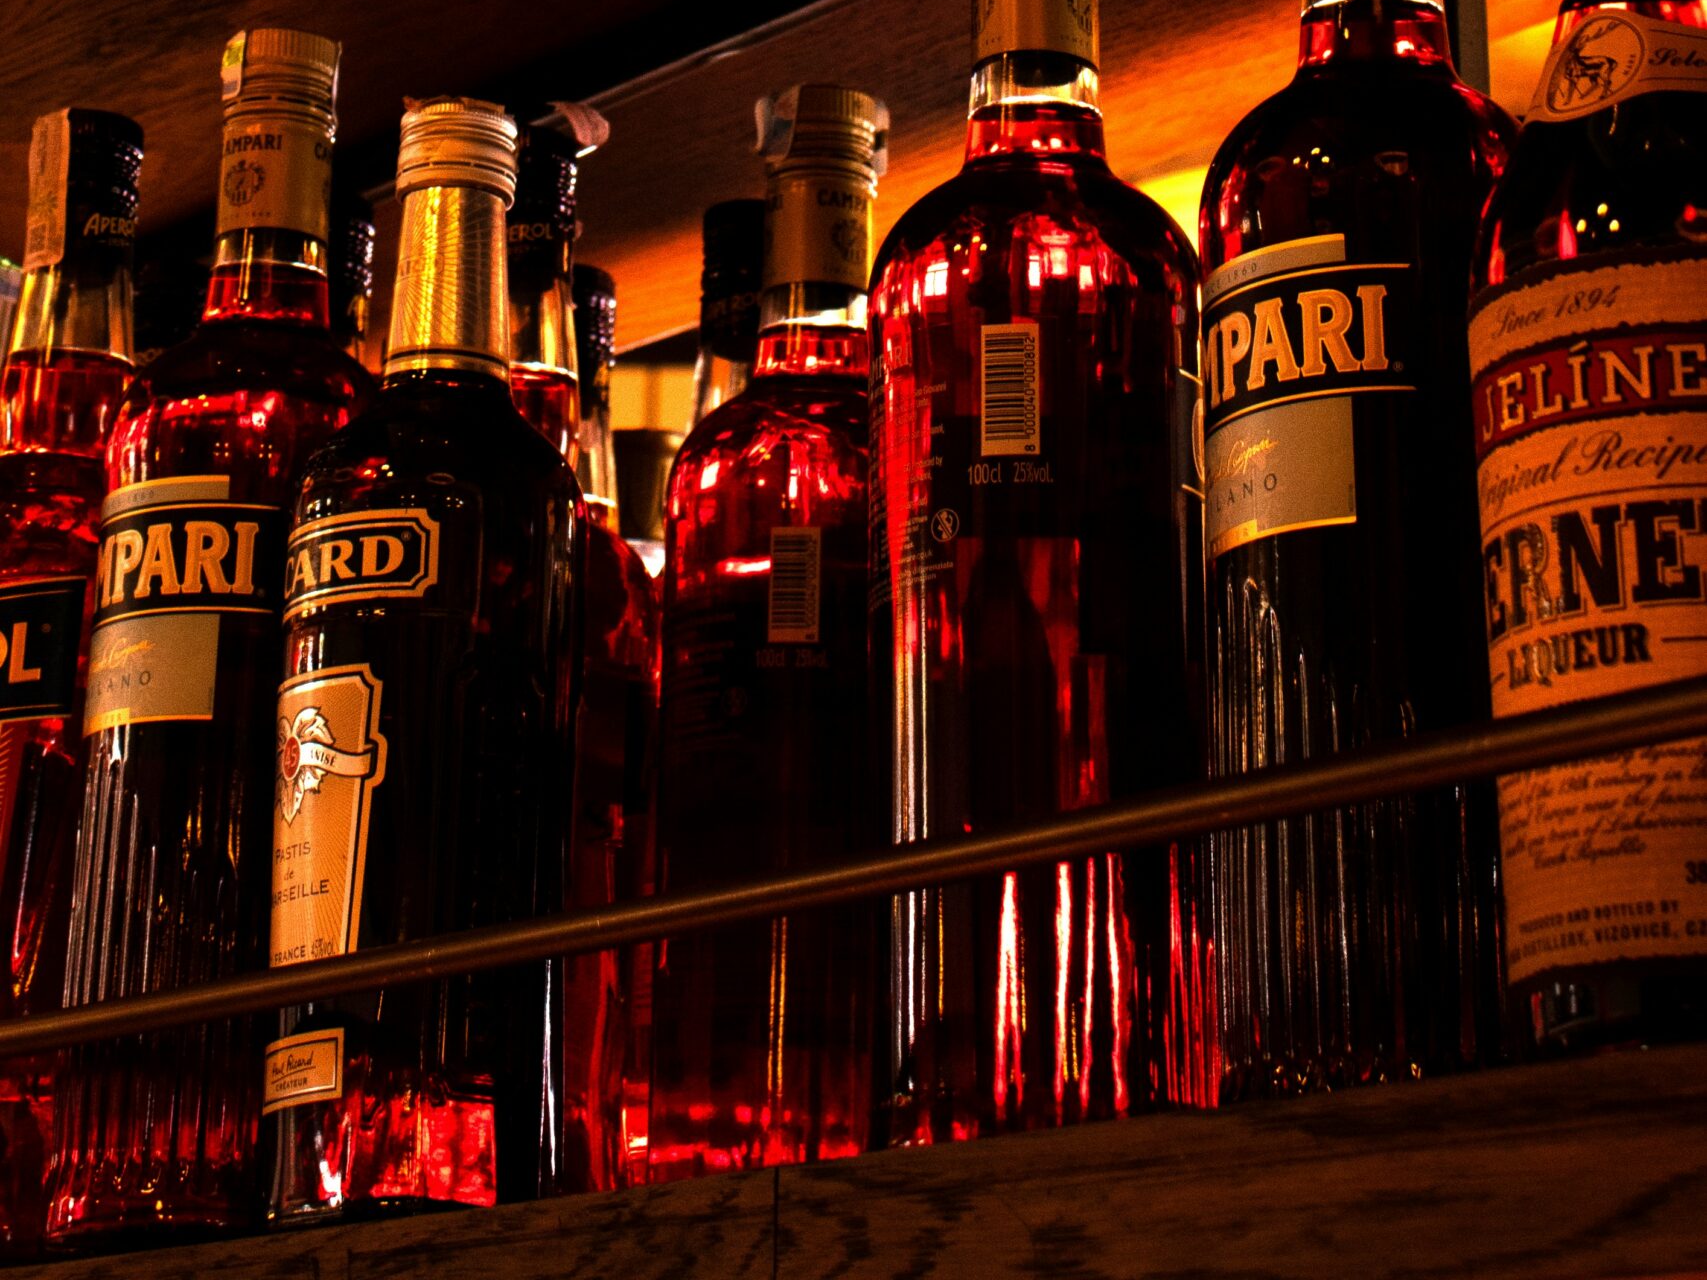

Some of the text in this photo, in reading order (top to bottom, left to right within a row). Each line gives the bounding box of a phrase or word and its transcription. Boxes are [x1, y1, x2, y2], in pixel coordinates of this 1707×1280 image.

[223, 134, 283, 156] AMPARI
[508, 223, 553, 241] EROL
[1554, 285, 1620, 318] 1894
[1483, 340, 1707, 443] JELÍNE
[968, 461, 1054, 485] 100cl 25%vol.
[284, 534, 405, 601] CARD
[1508, 623, 1652, 689] LIQUEUR
[275, 841, 311, 865] PASTIS
[272, 879, 330, 908] ARSEILLE
[1594, 901, 1655, 920] BOTTLED
[274, 946, 306, 966] FRANCE
[274, 1077, 308, 1091] CRÉATEUR
